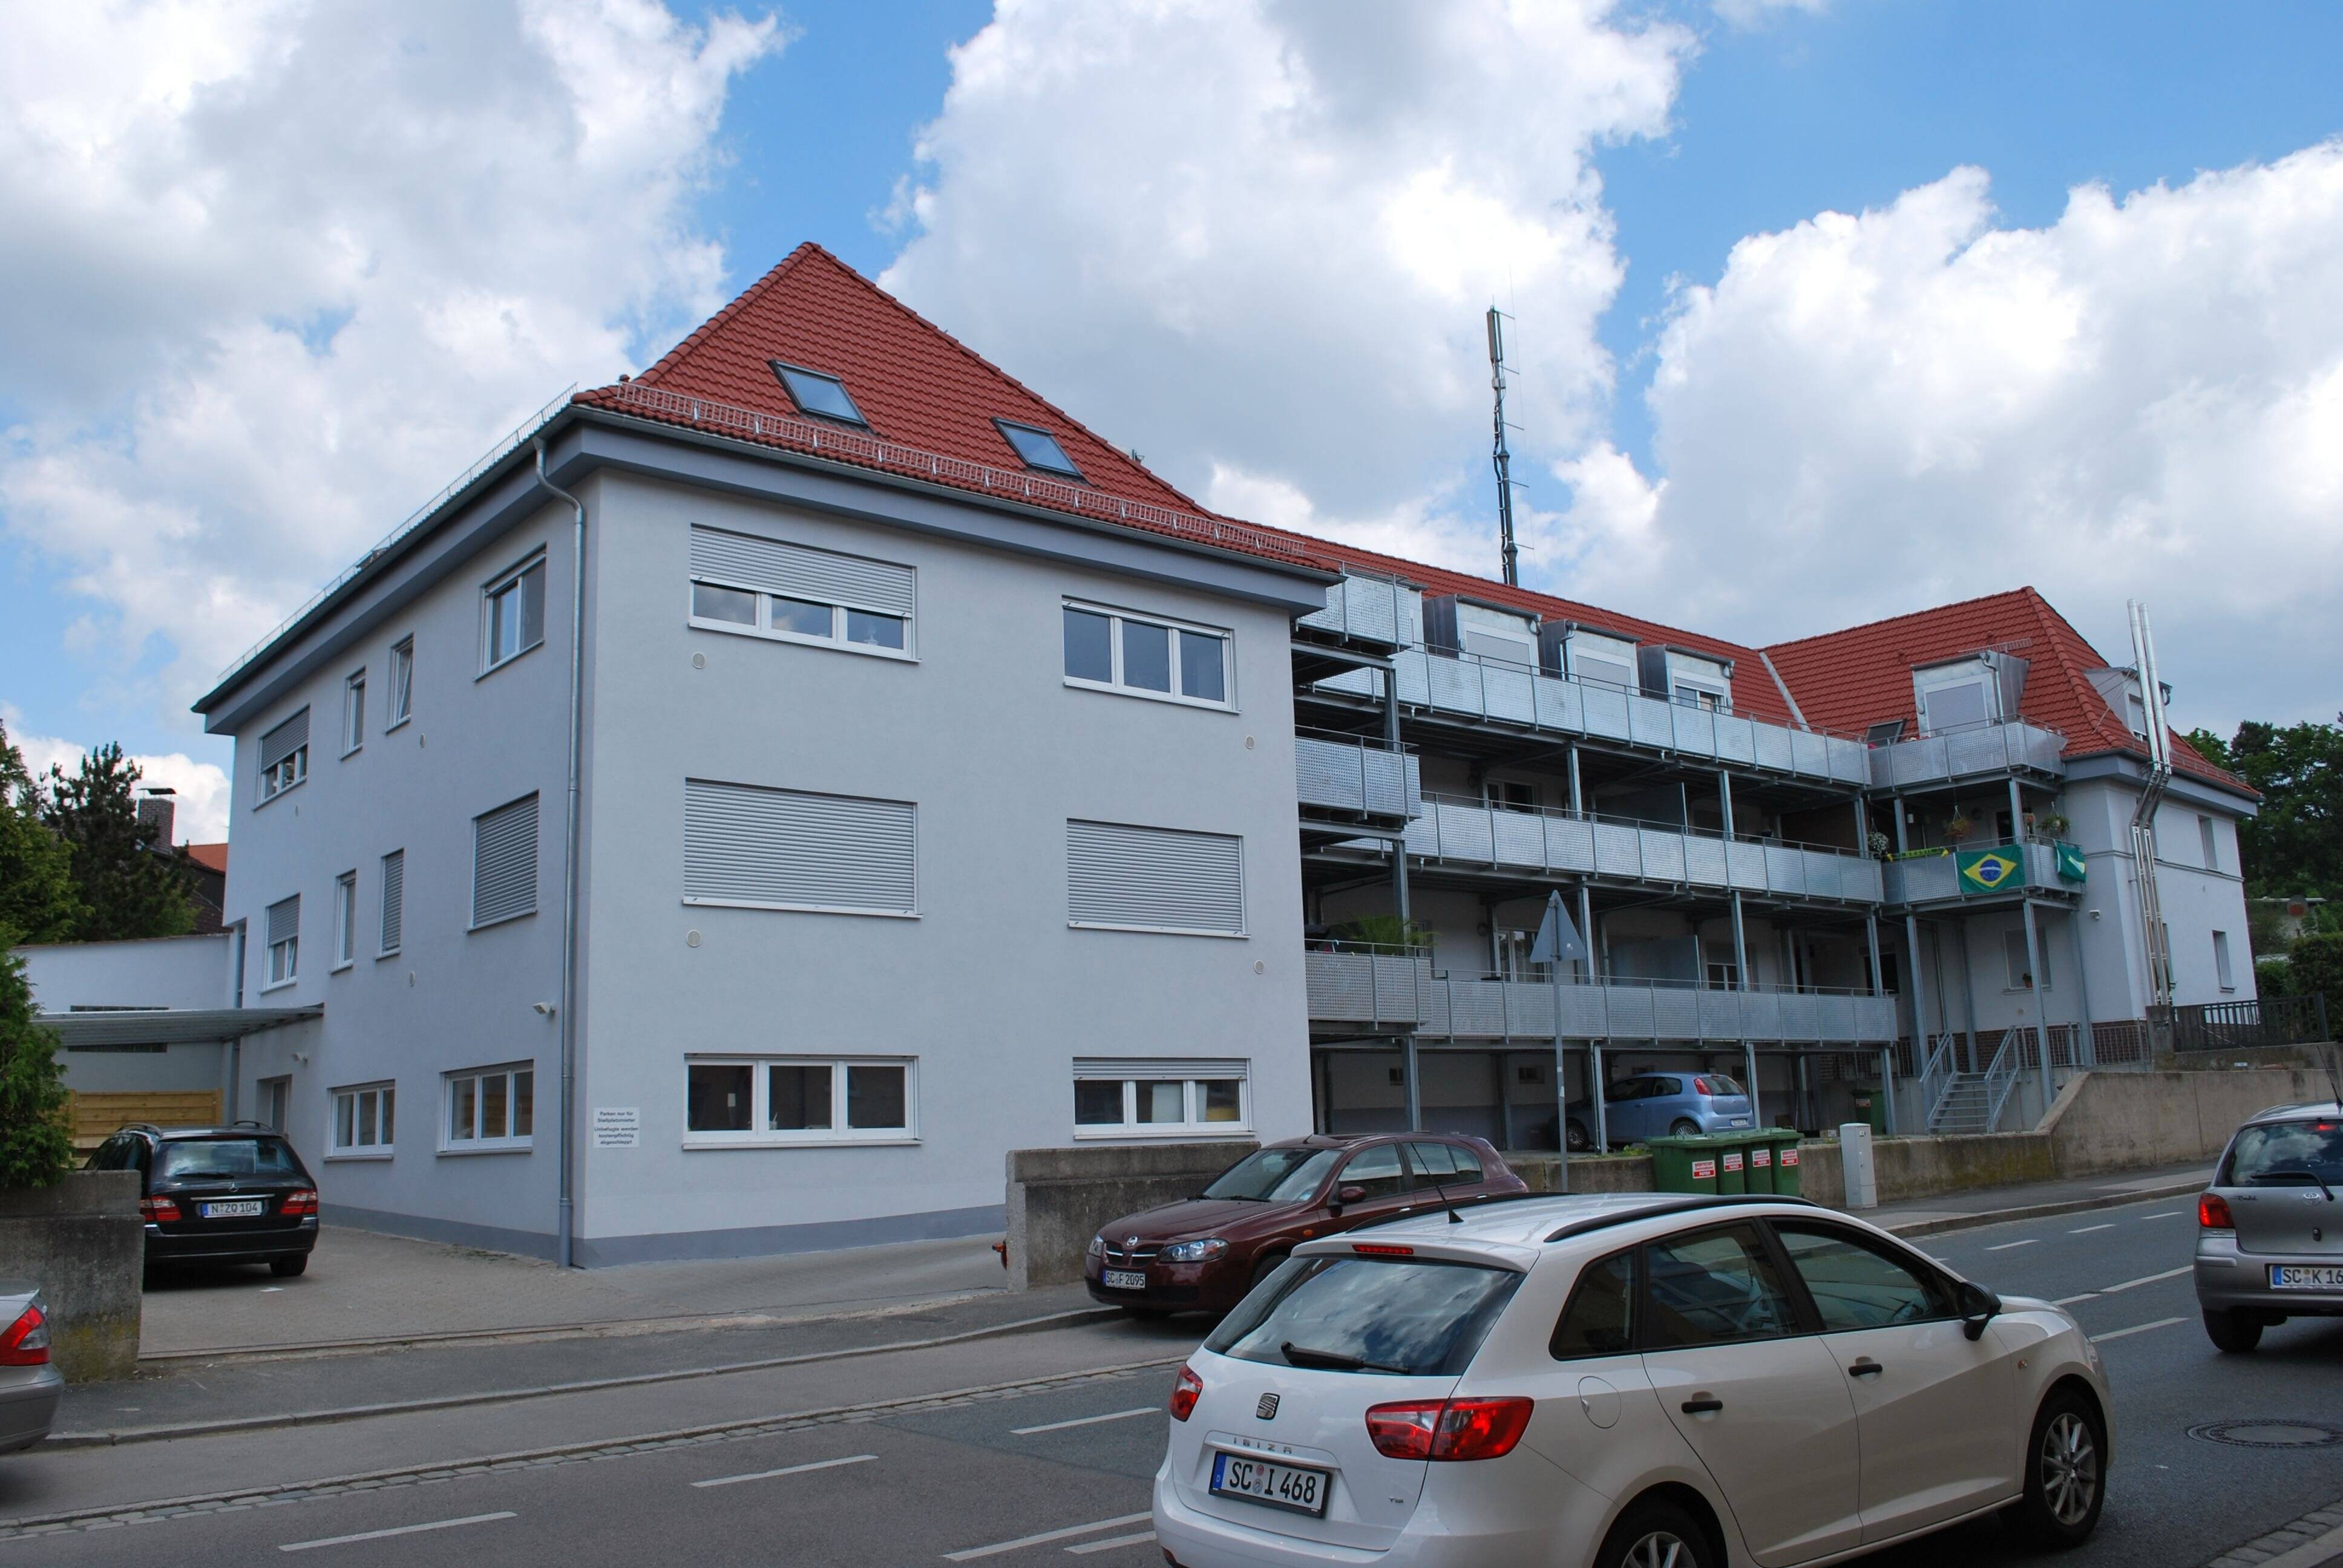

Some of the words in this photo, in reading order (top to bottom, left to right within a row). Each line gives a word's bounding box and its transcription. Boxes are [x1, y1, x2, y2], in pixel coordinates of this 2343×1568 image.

[211, 1204, 218, 1214] N
[240, 1203, 258, 1213] 104
[1107, 1272, 1115, 1284] SC
[1119, 1273, 1124, 1284] F
[1126, 1274, 1144, 1286] 2095
[2282, 1269, 2302, 1284] SC
[2312, 1269, 2322, 1284] K
[1234, 1436, 1293, 1454] IBIZA
[1229, 1462, 1253, 1490] SC
[1264, 1468, 1274, 1496] I
[1279, 1471, 1317, 1504] 468
